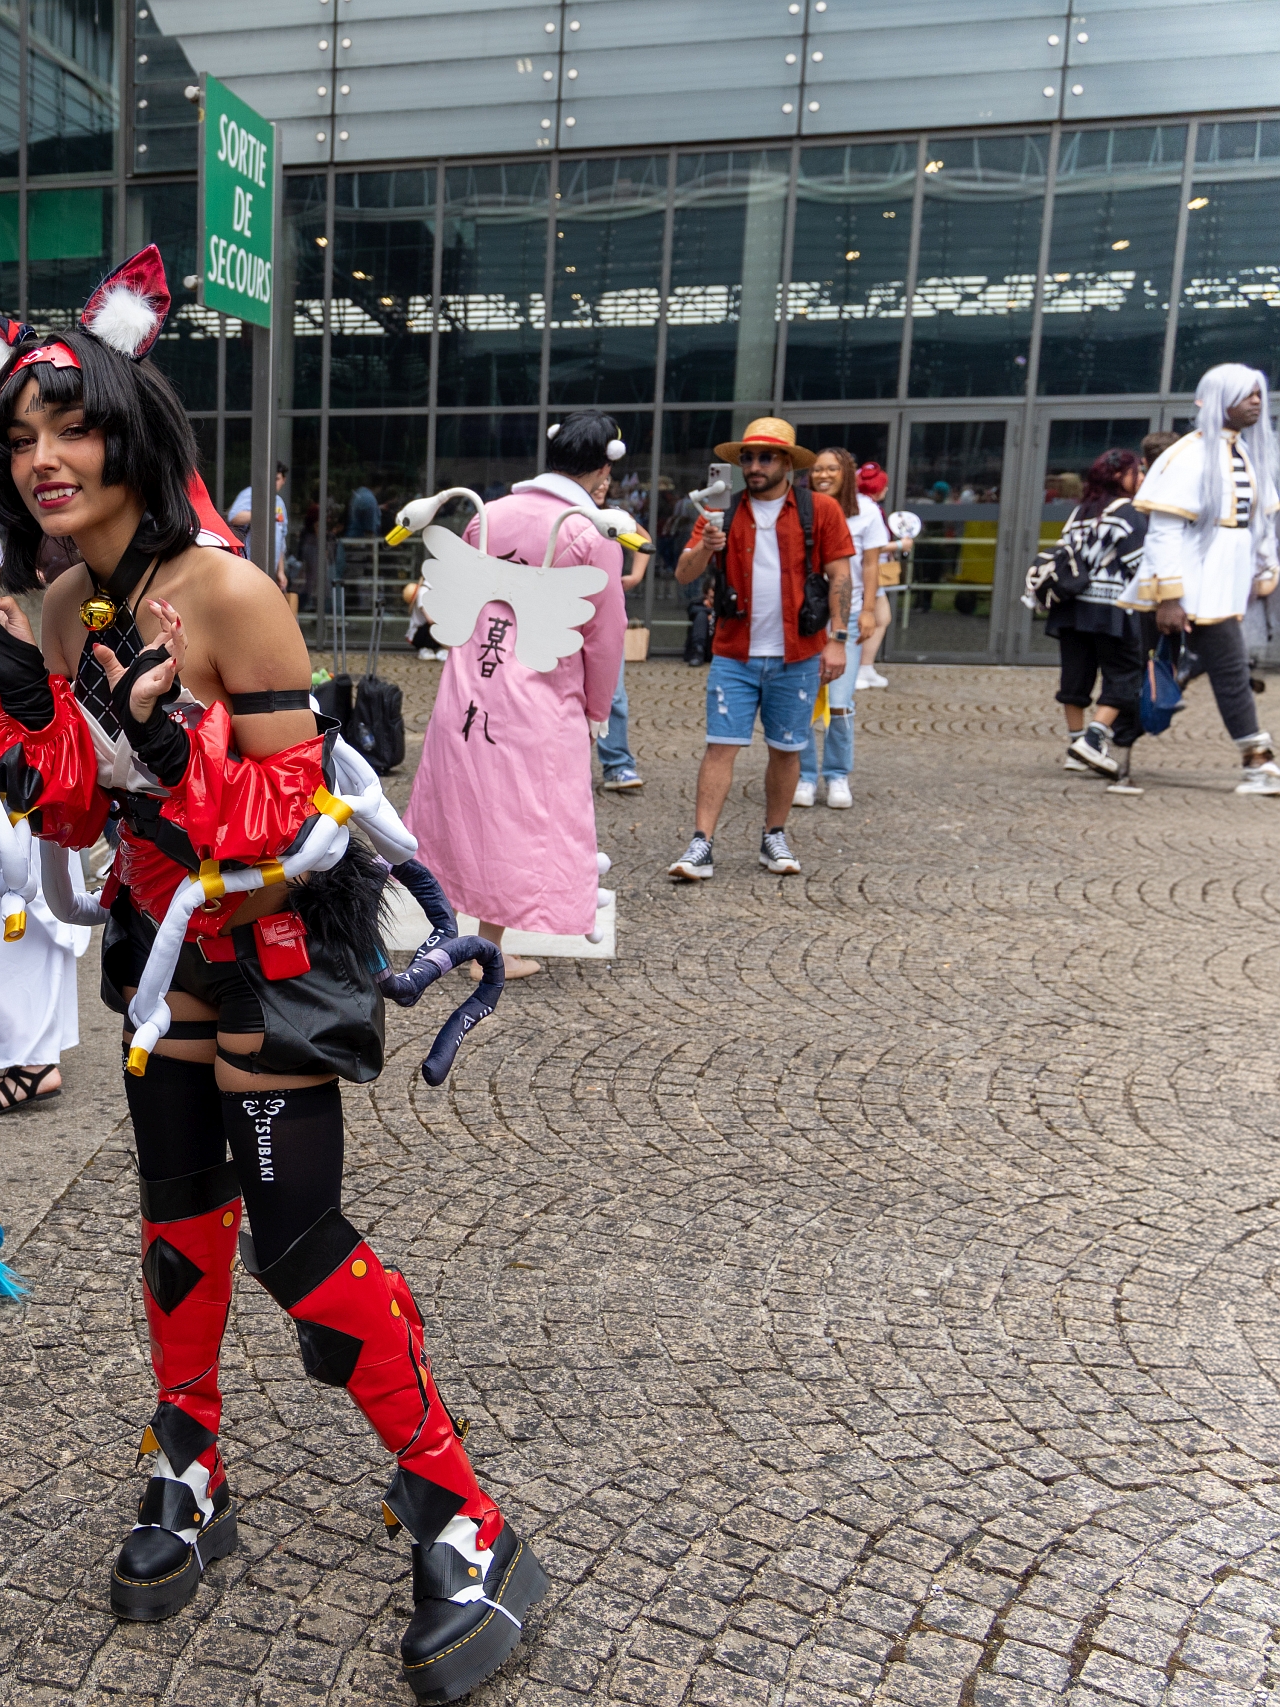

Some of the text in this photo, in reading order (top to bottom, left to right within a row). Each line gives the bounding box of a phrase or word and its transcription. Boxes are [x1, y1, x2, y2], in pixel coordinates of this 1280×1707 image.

[217, 113, 267, 188] SORTIE
[232, 185, 253, 238] DE
[207, 234, 272, 304] SECOURS
[254, 1116, 275, 1181] TSUBAKI
